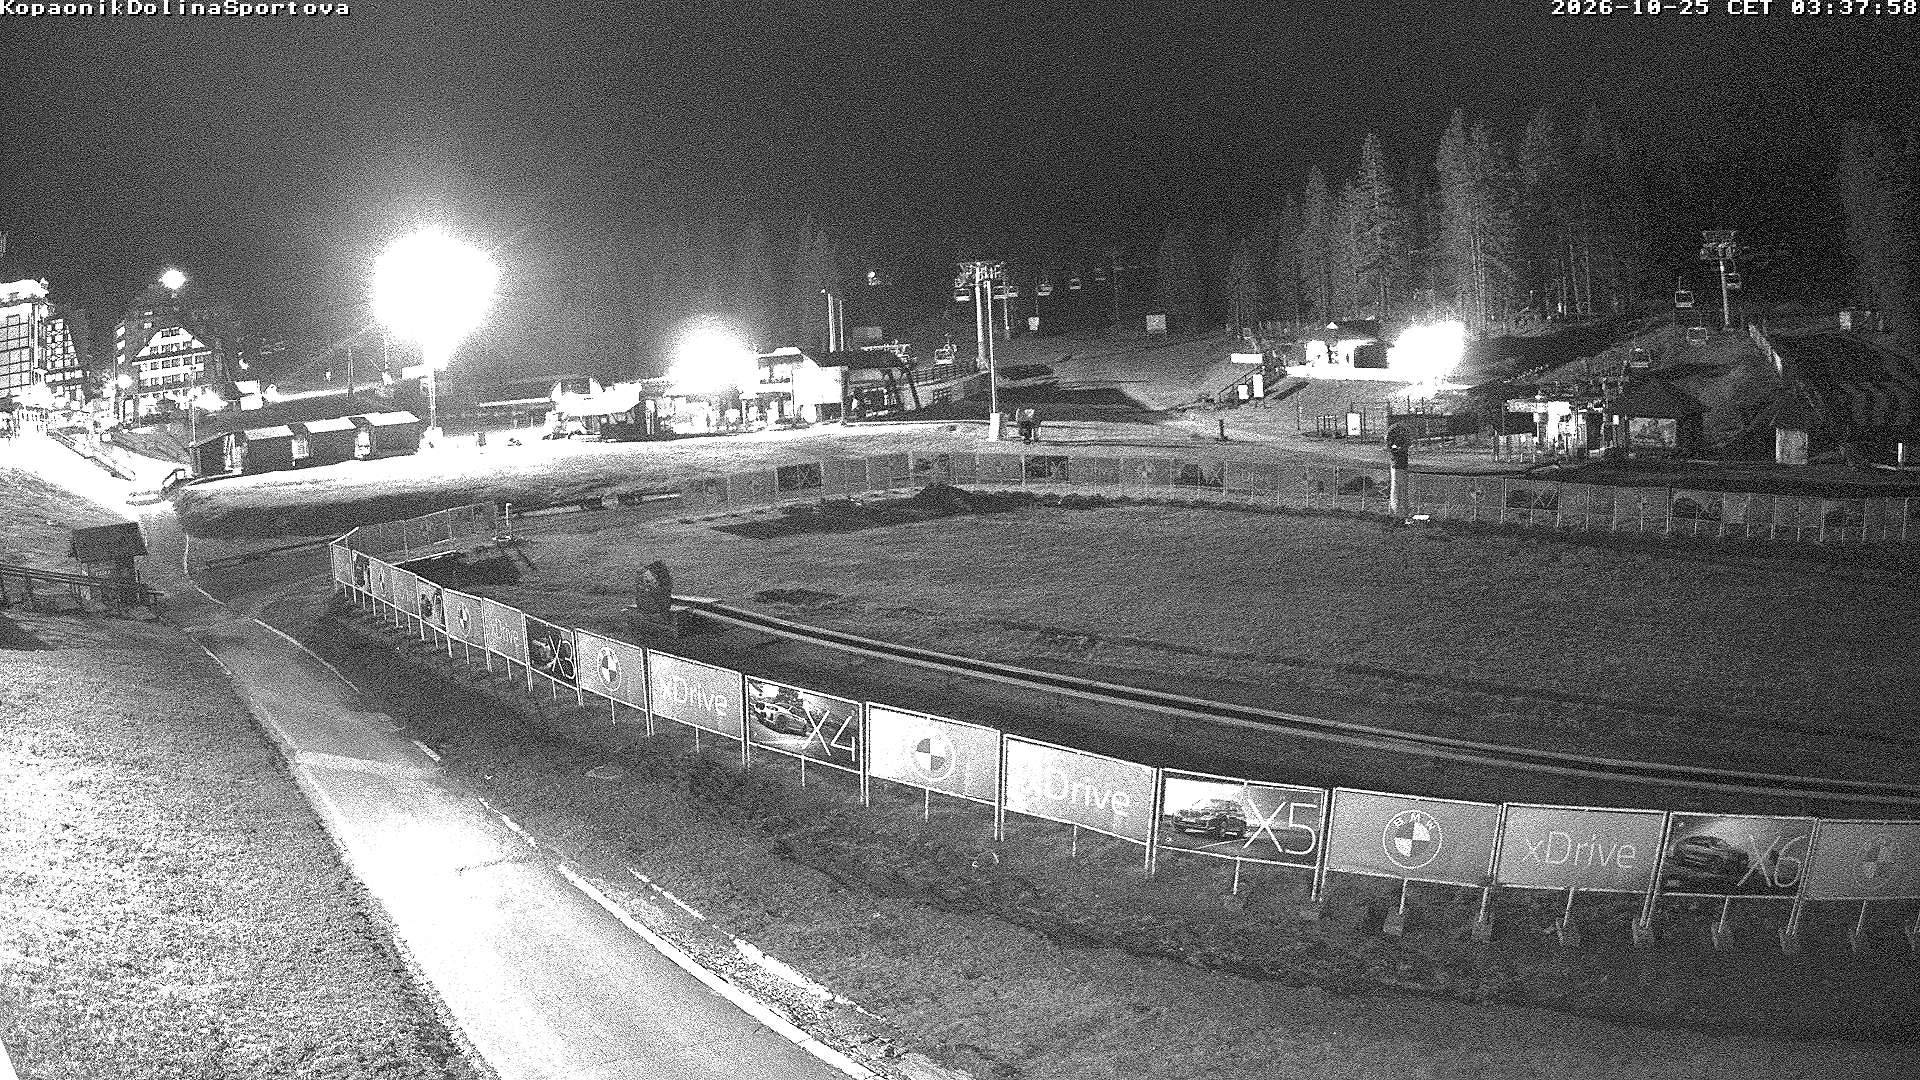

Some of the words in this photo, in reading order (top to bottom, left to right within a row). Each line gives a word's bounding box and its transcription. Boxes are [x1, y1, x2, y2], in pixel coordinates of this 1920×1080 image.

[548, 635, 575, 680] X3
[802, 703, 856, 762] X4
[1243, 799, 1318, 855] X5
[1521, 830, 1638, 869] xDrive
[1736, 834, 1809, 888] X6
